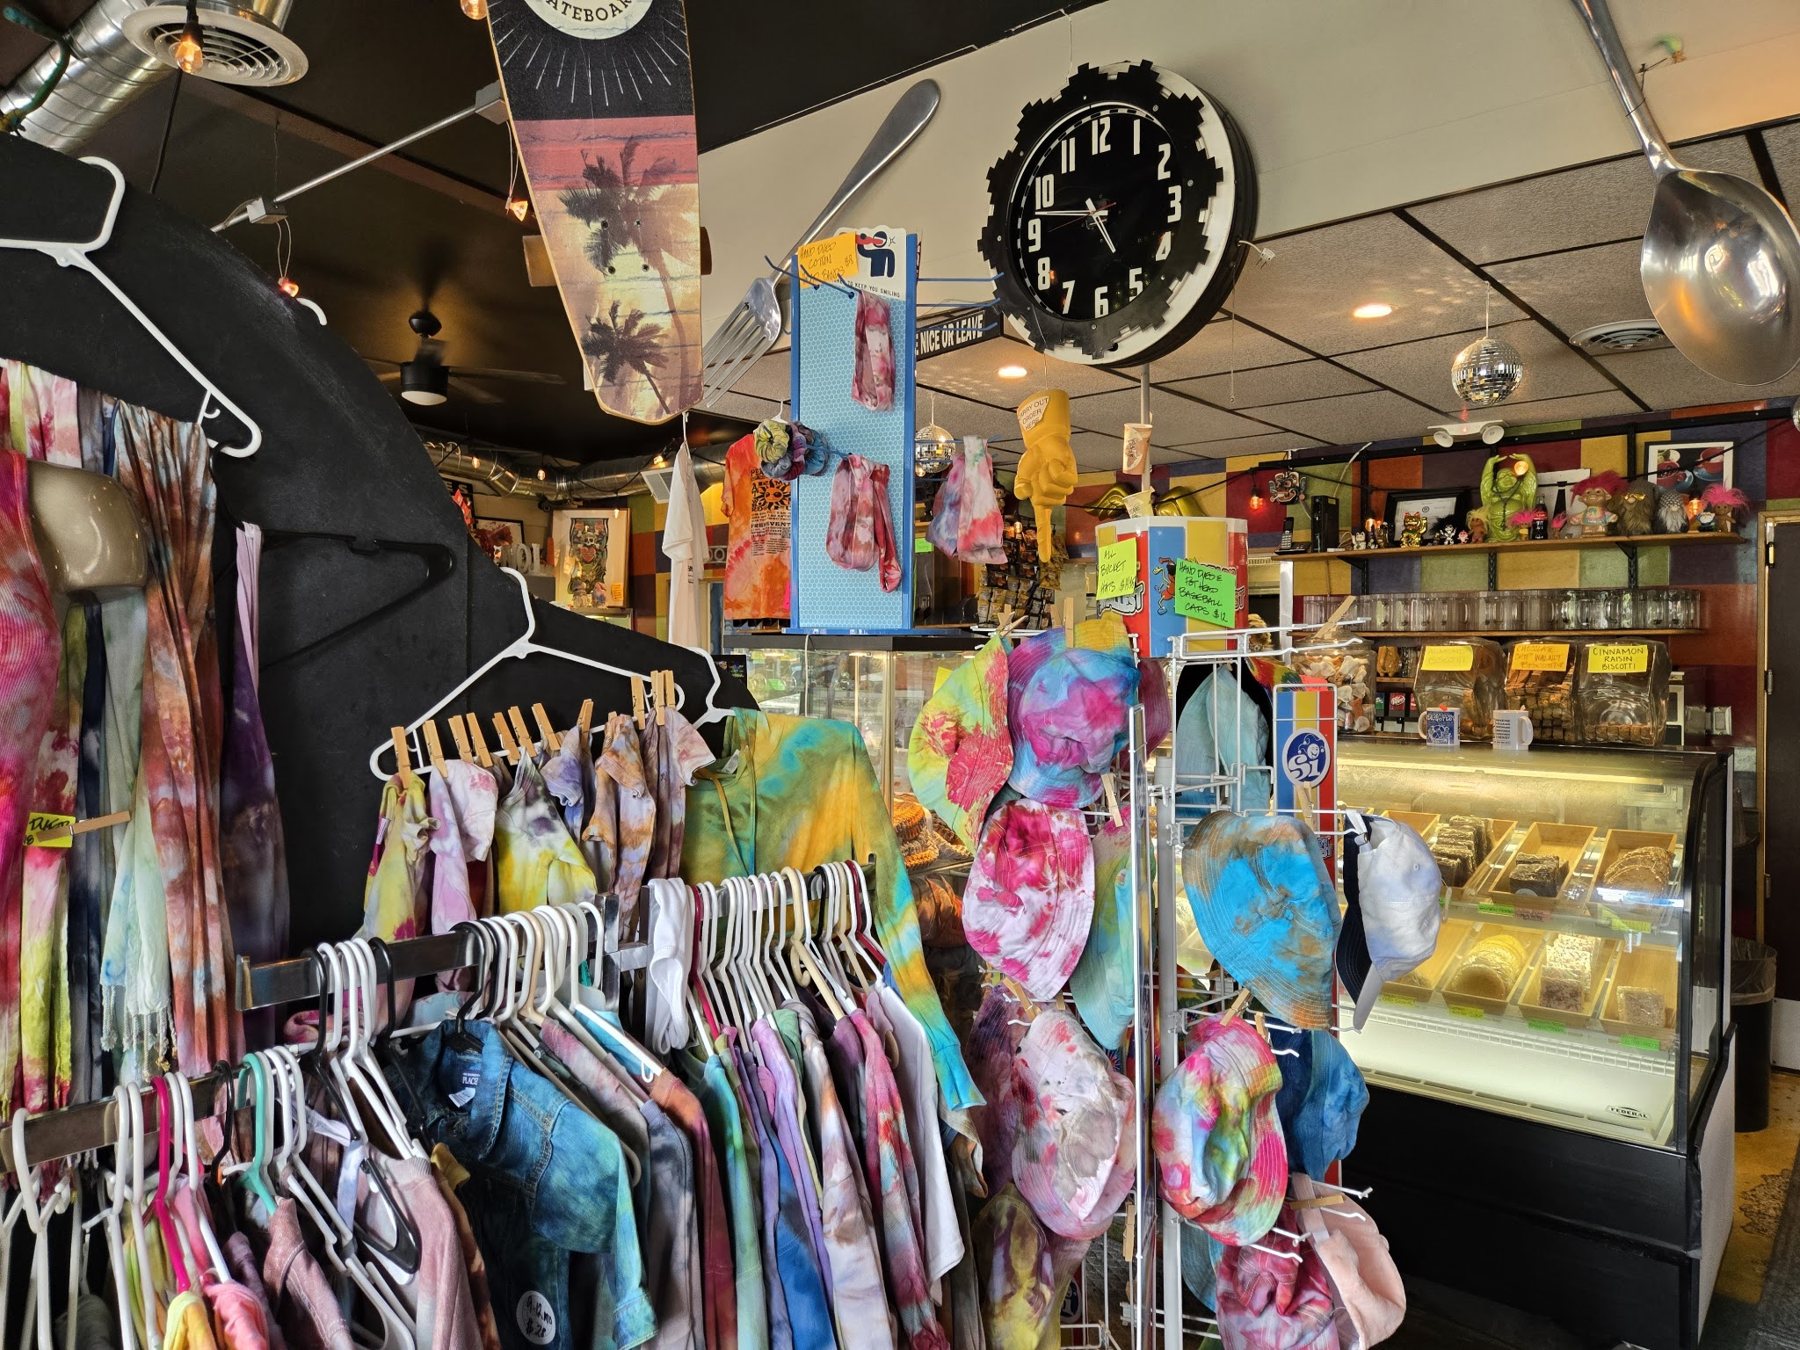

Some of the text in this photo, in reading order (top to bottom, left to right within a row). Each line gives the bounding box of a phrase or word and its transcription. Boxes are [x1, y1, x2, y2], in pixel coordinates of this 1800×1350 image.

[1091, 117, 1111, 155] 12
[1133, 119, 1141, 155] 1
[1061, 137, 1076, 174] 11
[1157, 143, 1171, 180] 2
[1035, 174, 1054, 210] 10
[1167, 185, 1182, 223] 3
[1028, 218, 1041, 253] 9
[1155, 231, 1172, 261] 4
[854, 282, 867, 291] KEEP
[868, 285, 878, 293] YOU
[1037, 257, 1050, 290] 8
[1129, 267, 1143, 302] 5
[1062, 280, 1075, 314] 7
[1094, 286, 1109, 318] 6
[920, 330, 941, 355] NICE
[941, 323, 954, 348] OR
[956, 314, 984, 345] LEAVE
[1034, 397, 1049, 408] OUT
[1100, 560, 1127, 577] BUCKET
[1178, 562, 1195, 576] HAND
[1178, 587, 1223, 607] BASEBALL
[1185, 602, 1229, 623] CAPS $12
[1592, 647, 1644, 656] CINNAMON
[1601, 663, 1636, 671] BISCOTTI
[1609, 1107, 1648, 1119] FEDERAL
